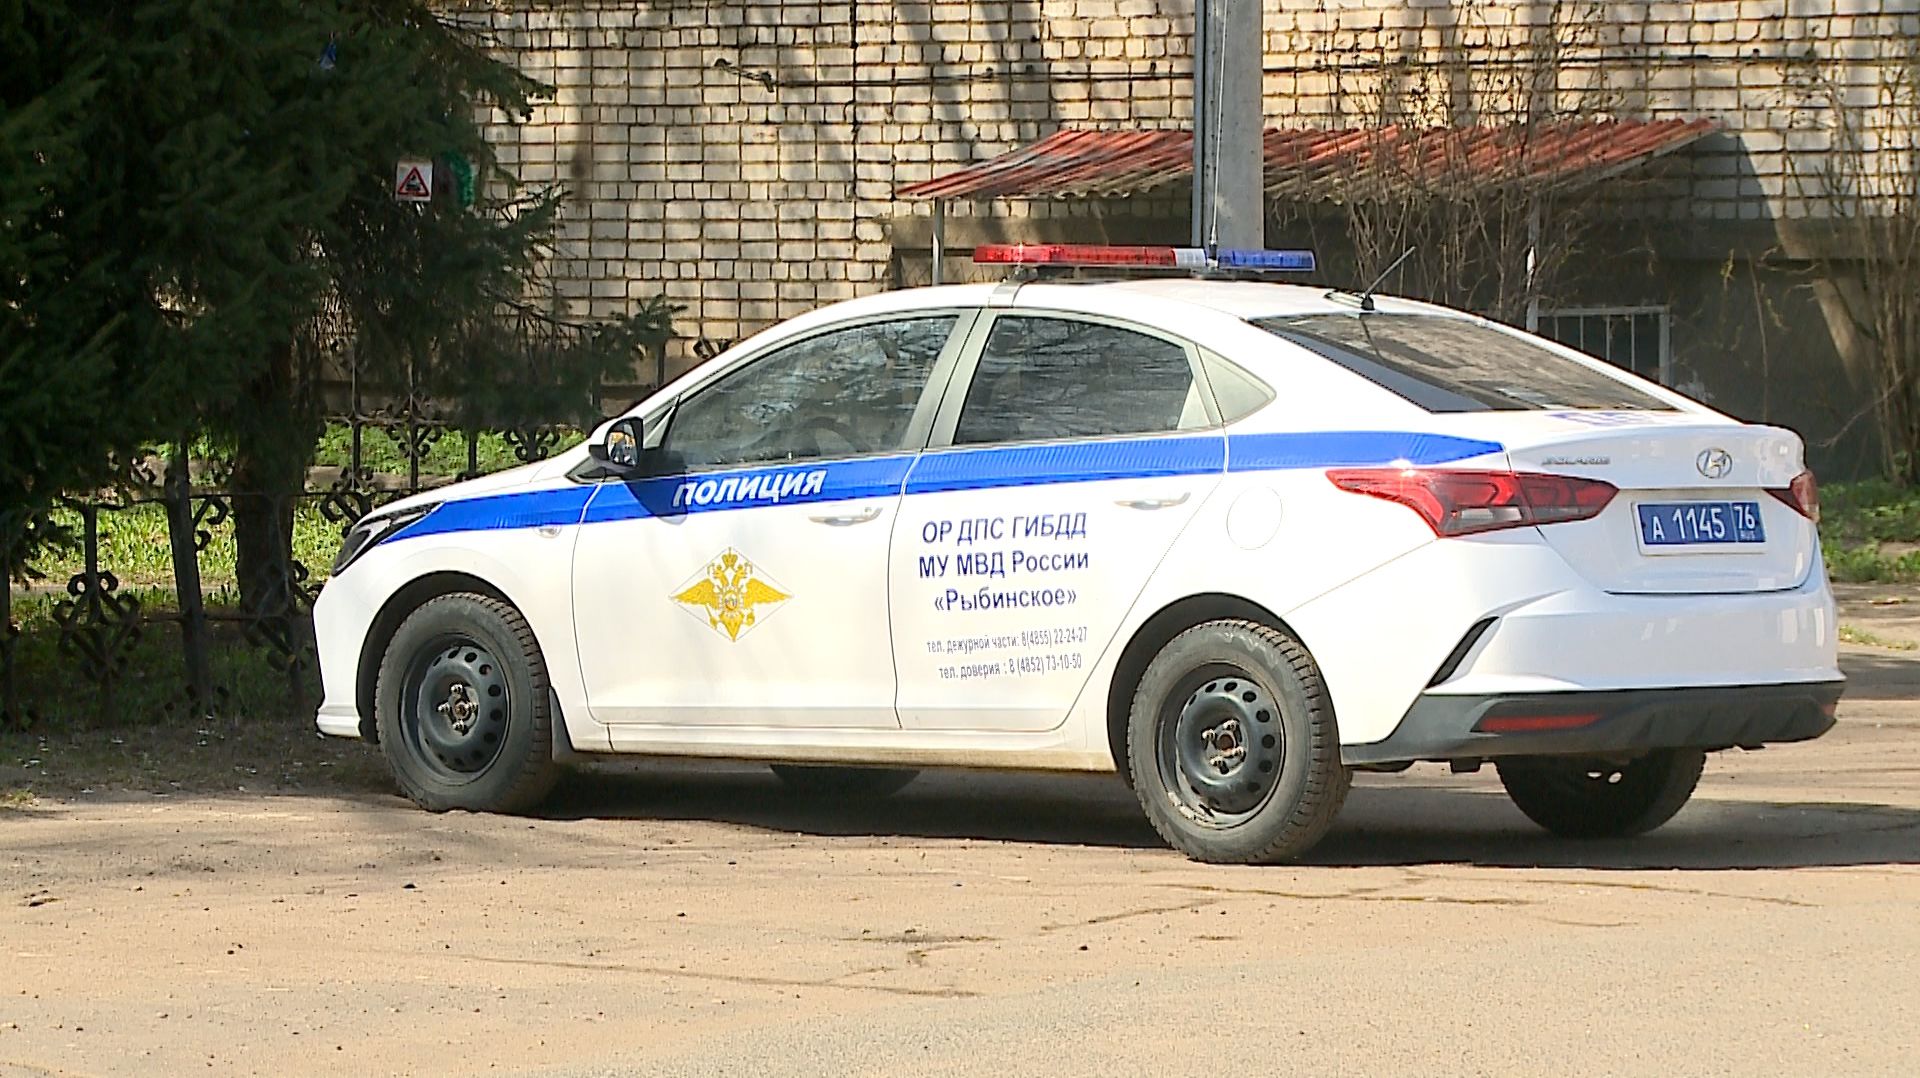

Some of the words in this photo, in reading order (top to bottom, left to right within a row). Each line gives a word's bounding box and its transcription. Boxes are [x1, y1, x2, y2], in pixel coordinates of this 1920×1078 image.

[672, 469, 828, 508] ПОЛИЦИЯ
[922, 520, 953, 544] ОР
[957, 517, 1004, 546] ДПС
[1012, 512, 1087, 541] ГИБДД
[1672, 508, 1726, 539] 1145
[1733, 504, 1757, 530] 76
[919, 554, 949, 579] МУ
[956, 551, 1005, 578] МВД
[1012, 550, 1089, 573] России
[934, 586, 1077, 611] «Рыбинское»
[926, 640, 945, 653] тел.
[947, 634, 990, 654] дежурной
[992, 635, 1020, 648] части:
[938, 666, 959, 679] тел.
[960, 662, 1000, 680] доверия
